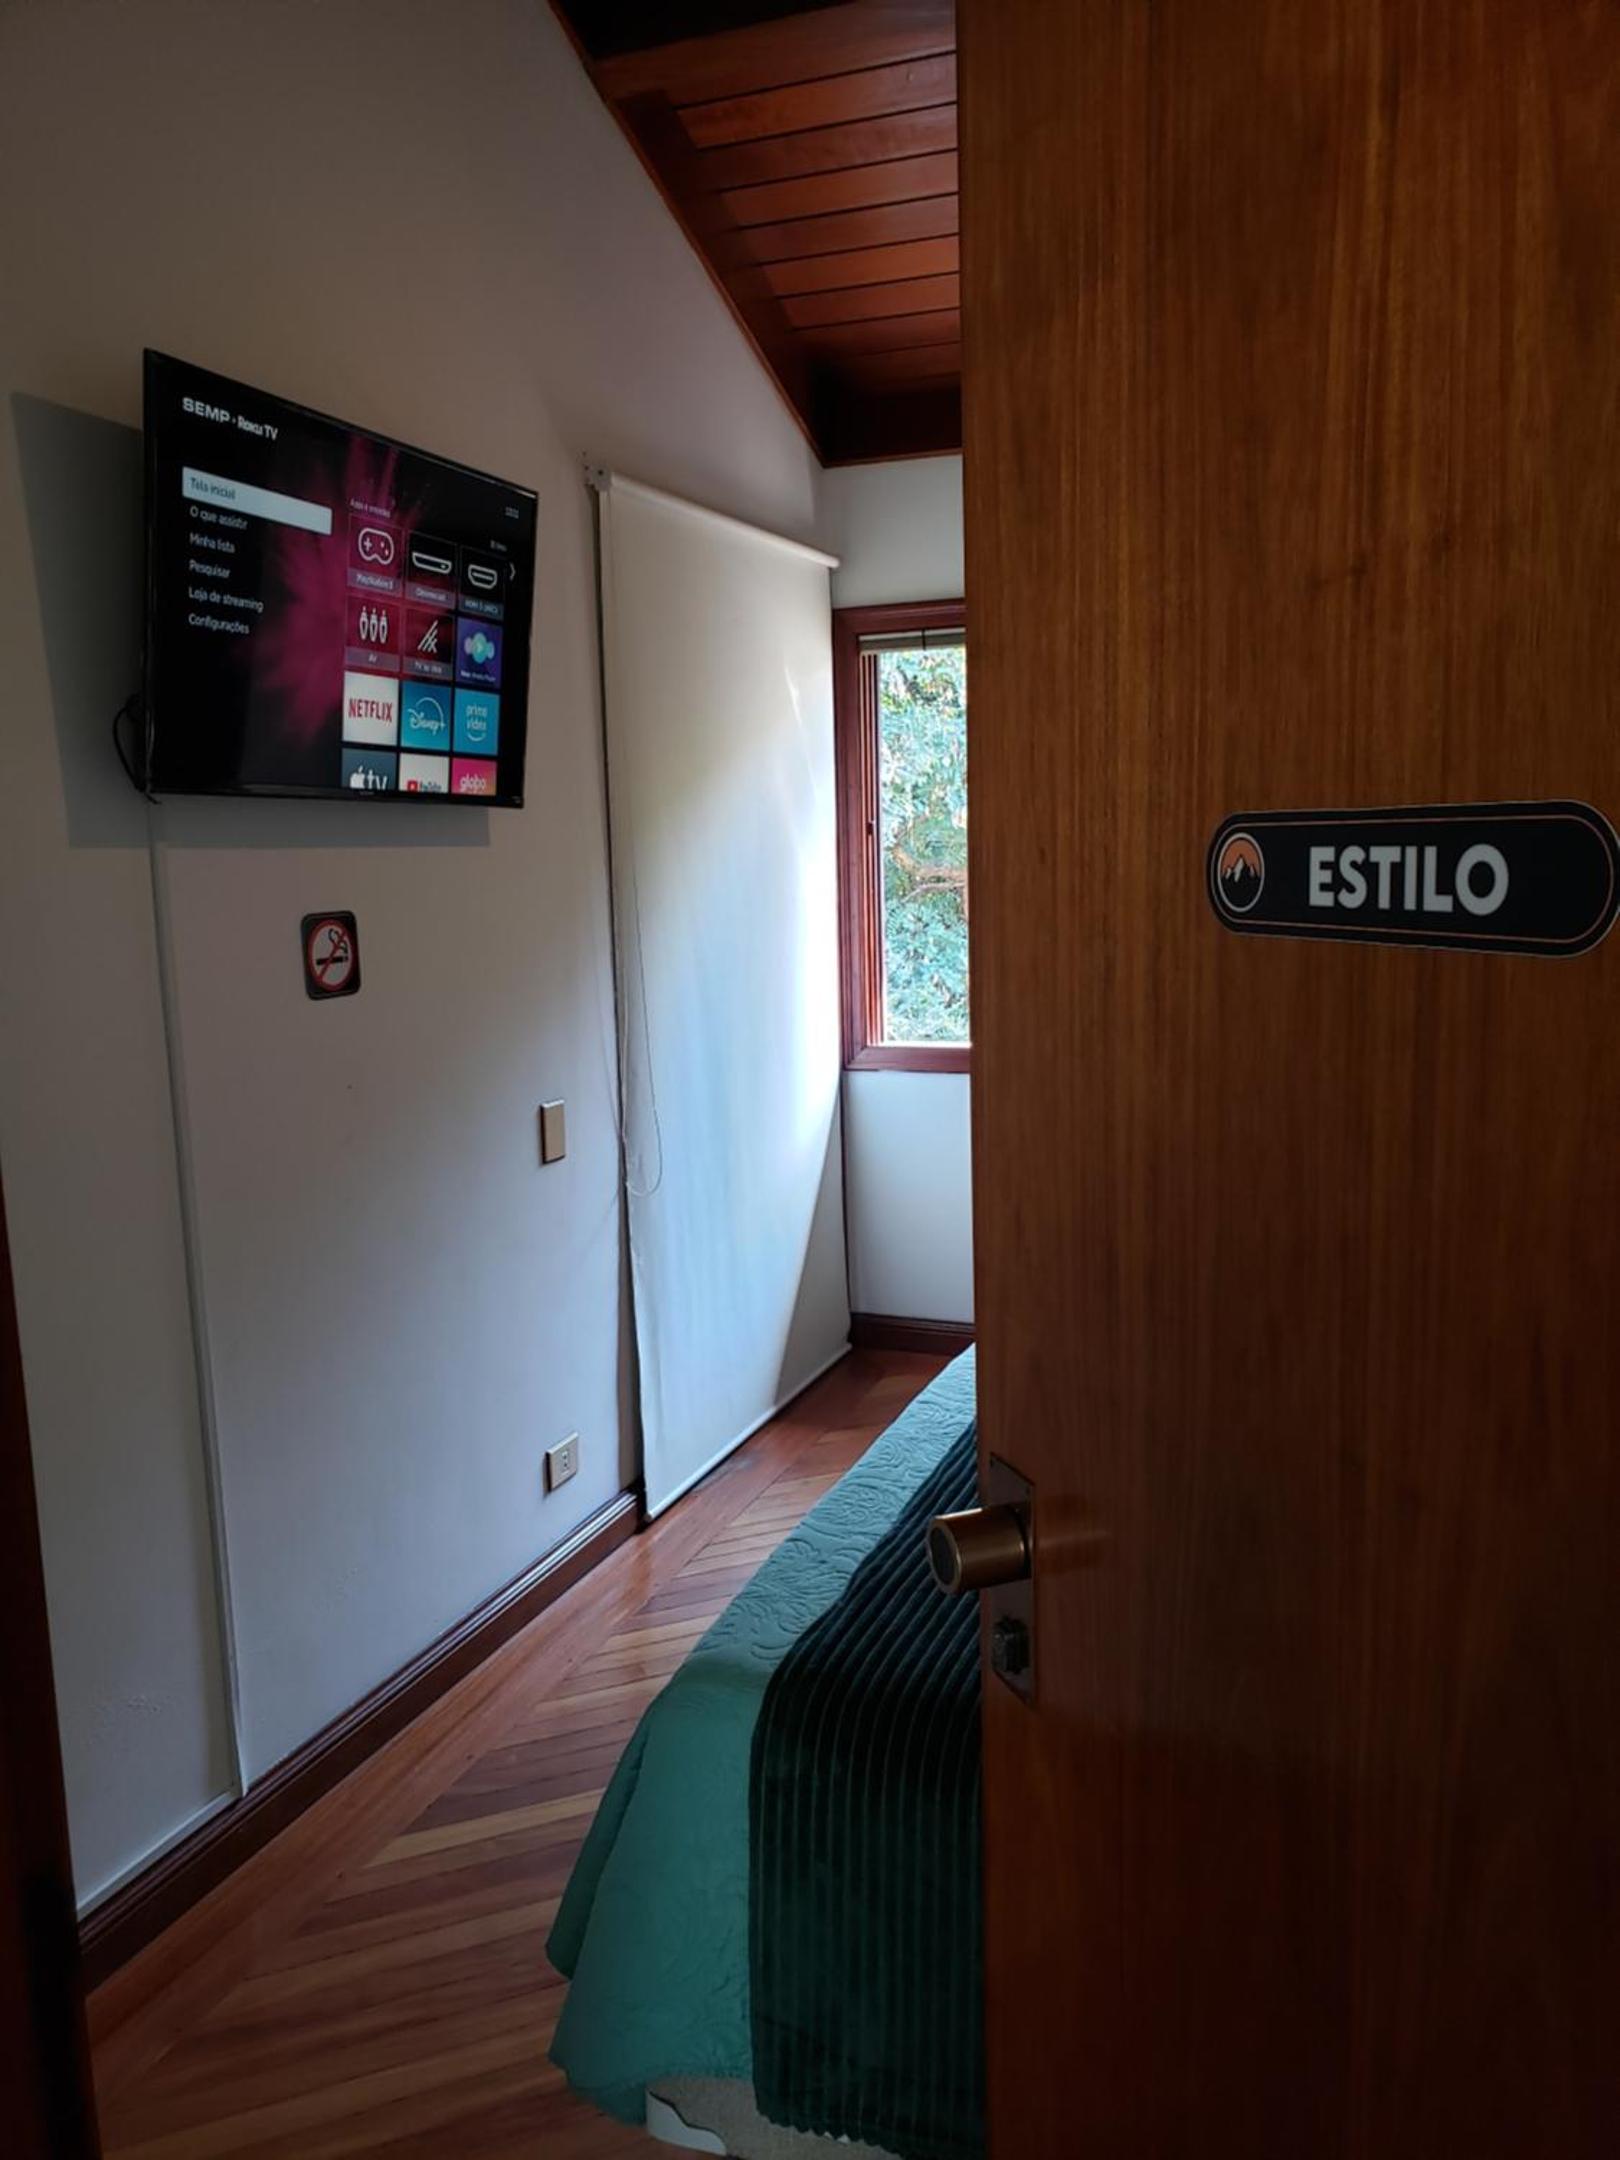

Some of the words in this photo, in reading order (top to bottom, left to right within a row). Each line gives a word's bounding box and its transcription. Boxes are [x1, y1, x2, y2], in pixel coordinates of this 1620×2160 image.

[182, 397, 231, 423] SEMP
[264, 424, 279, 440] TV
[190, 506, 199, 518] O
[189, 532, 216, 548] Minha
[217, 539, 236, 553] lista
[189, 559, 231, 579] Pesquisar
[188, 586, 208, 602] Loja
[209, 591, 220, 603] de
[222, 593, 264, 614] streaming
[188, 613, 250, 635] Configurações
[349, 698, 393, 722] NETFLIX
[466, 703, 488, 718] prime
[466, 716, 487, 731] video
[1308, 843, 1510, 916] ESTILO
